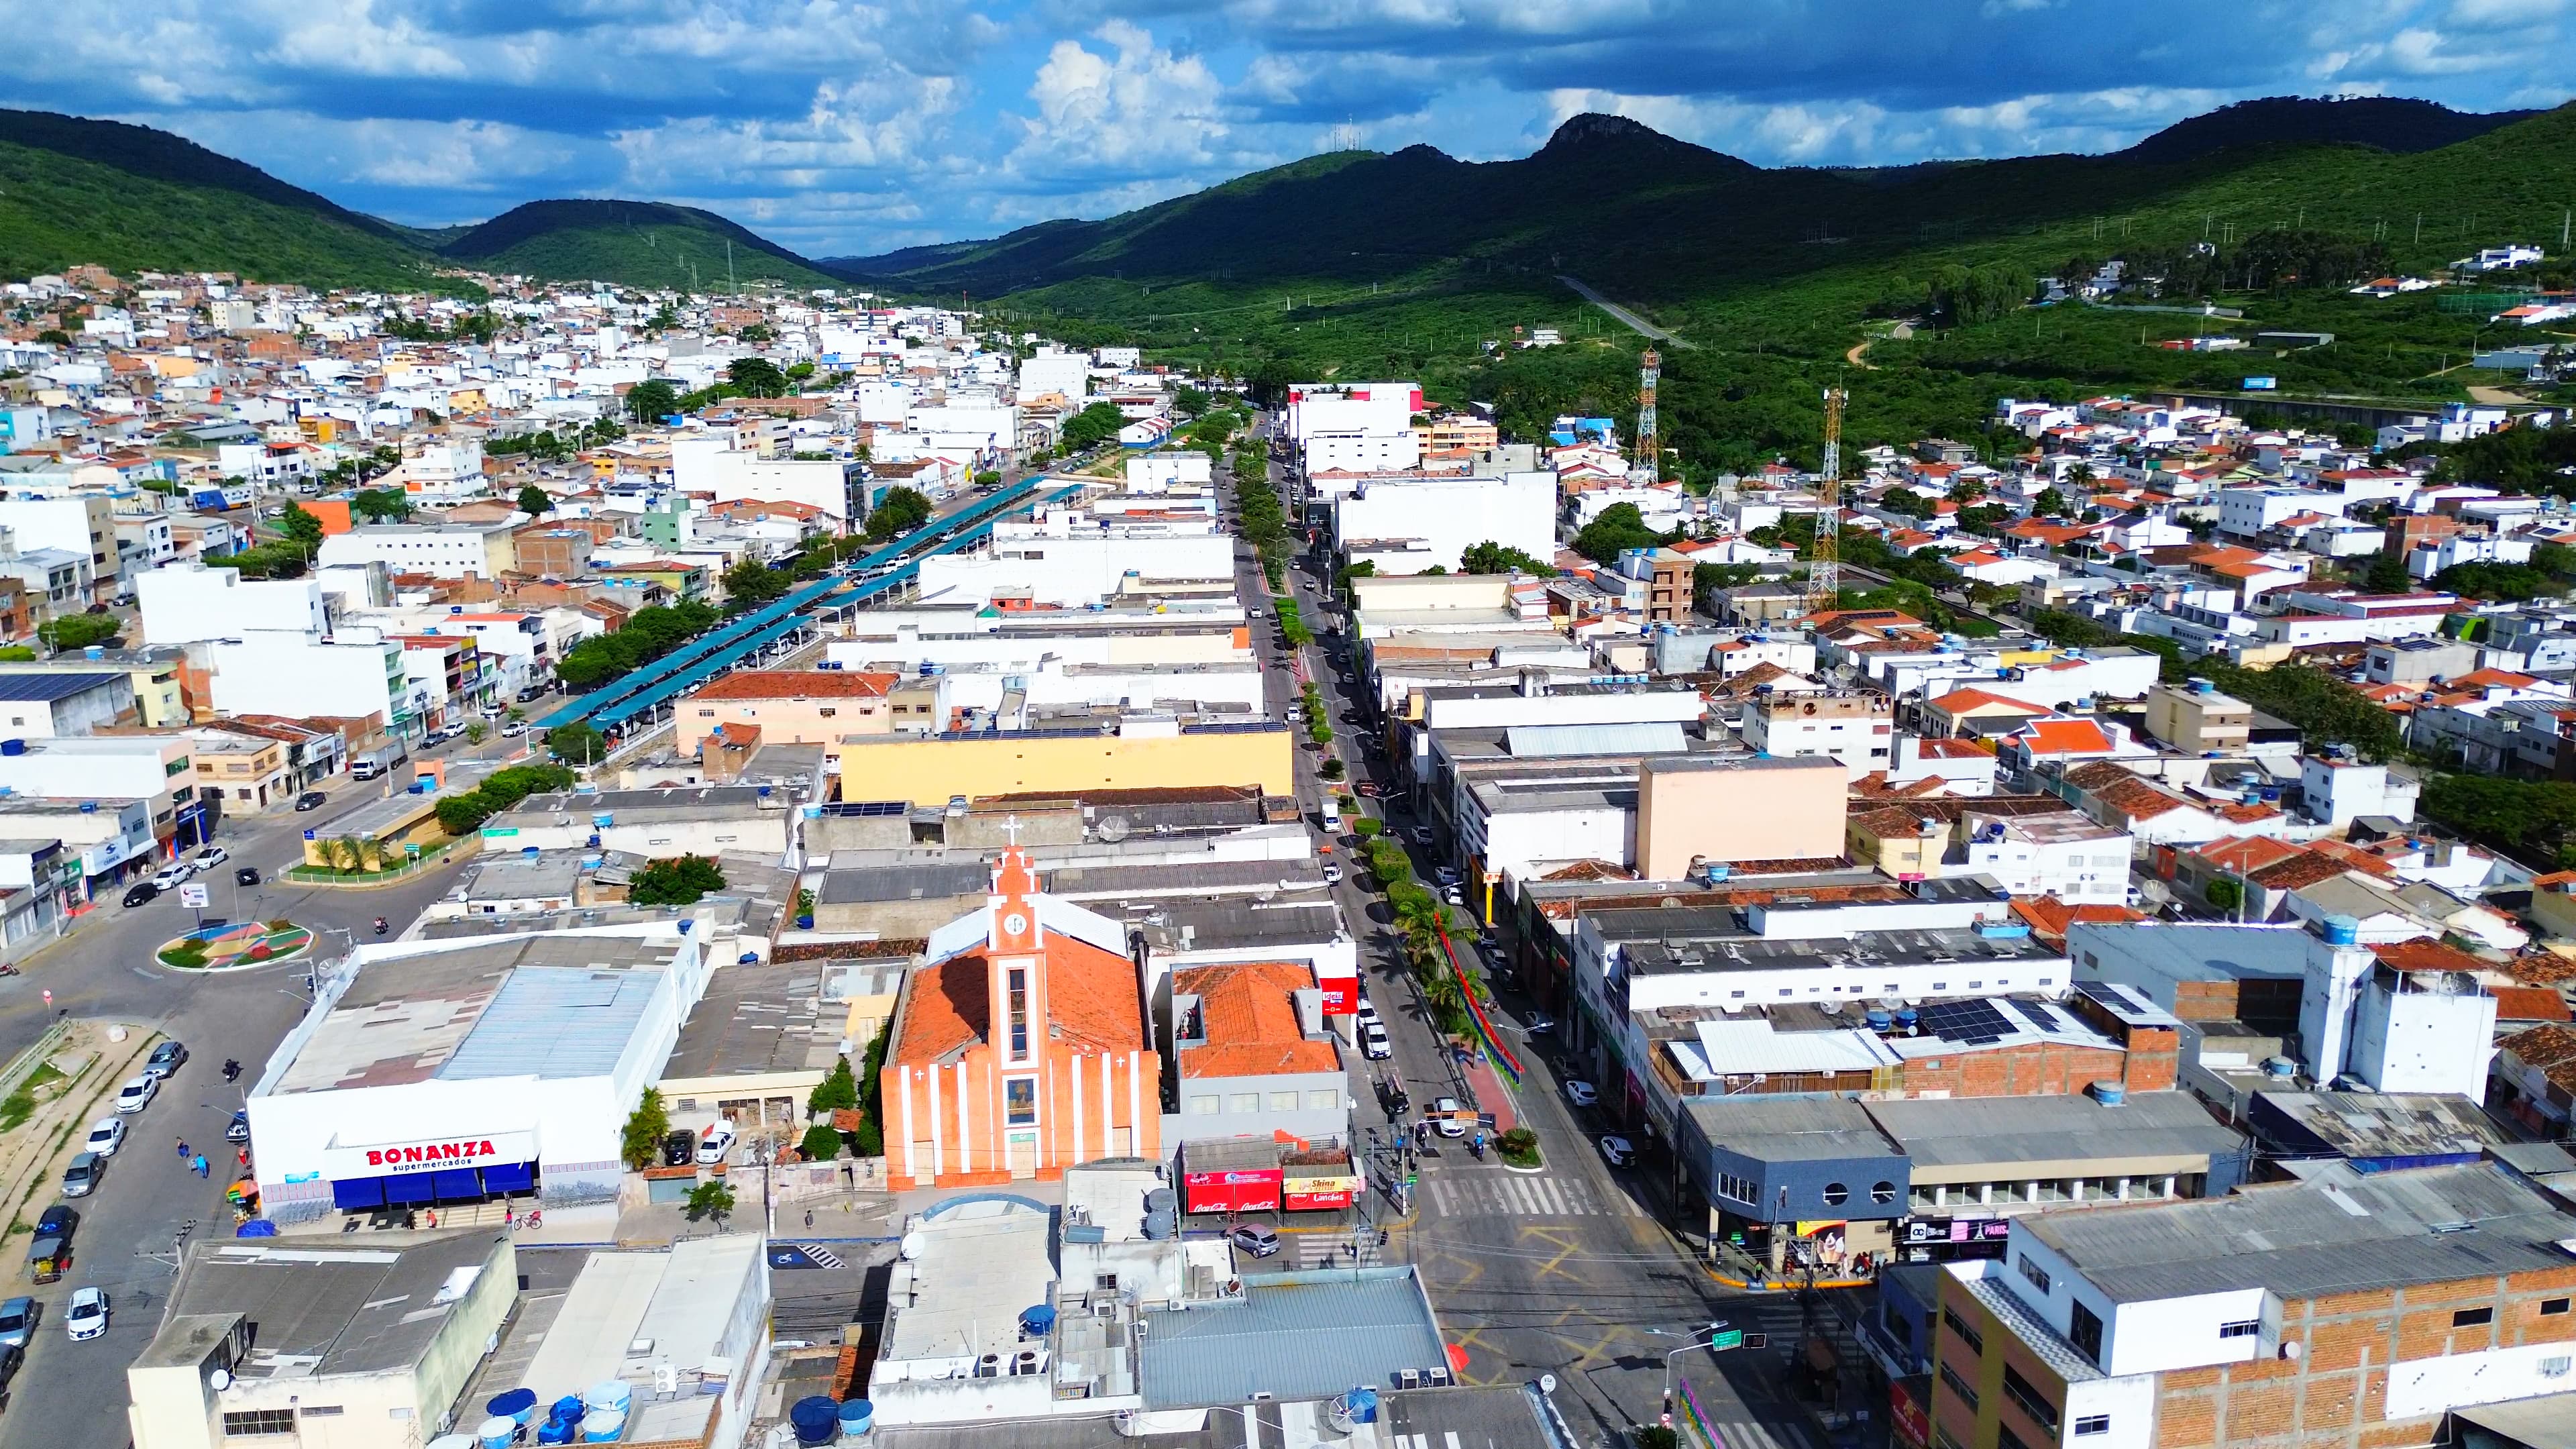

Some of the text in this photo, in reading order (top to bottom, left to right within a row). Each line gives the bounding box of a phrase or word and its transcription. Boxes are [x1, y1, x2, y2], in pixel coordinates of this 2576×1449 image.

[366, 1140, 496, 1165] BONANZA
[393, 1159, 472, 1171] supermercados
[1311, 1179, 1336, 1187] Skina
